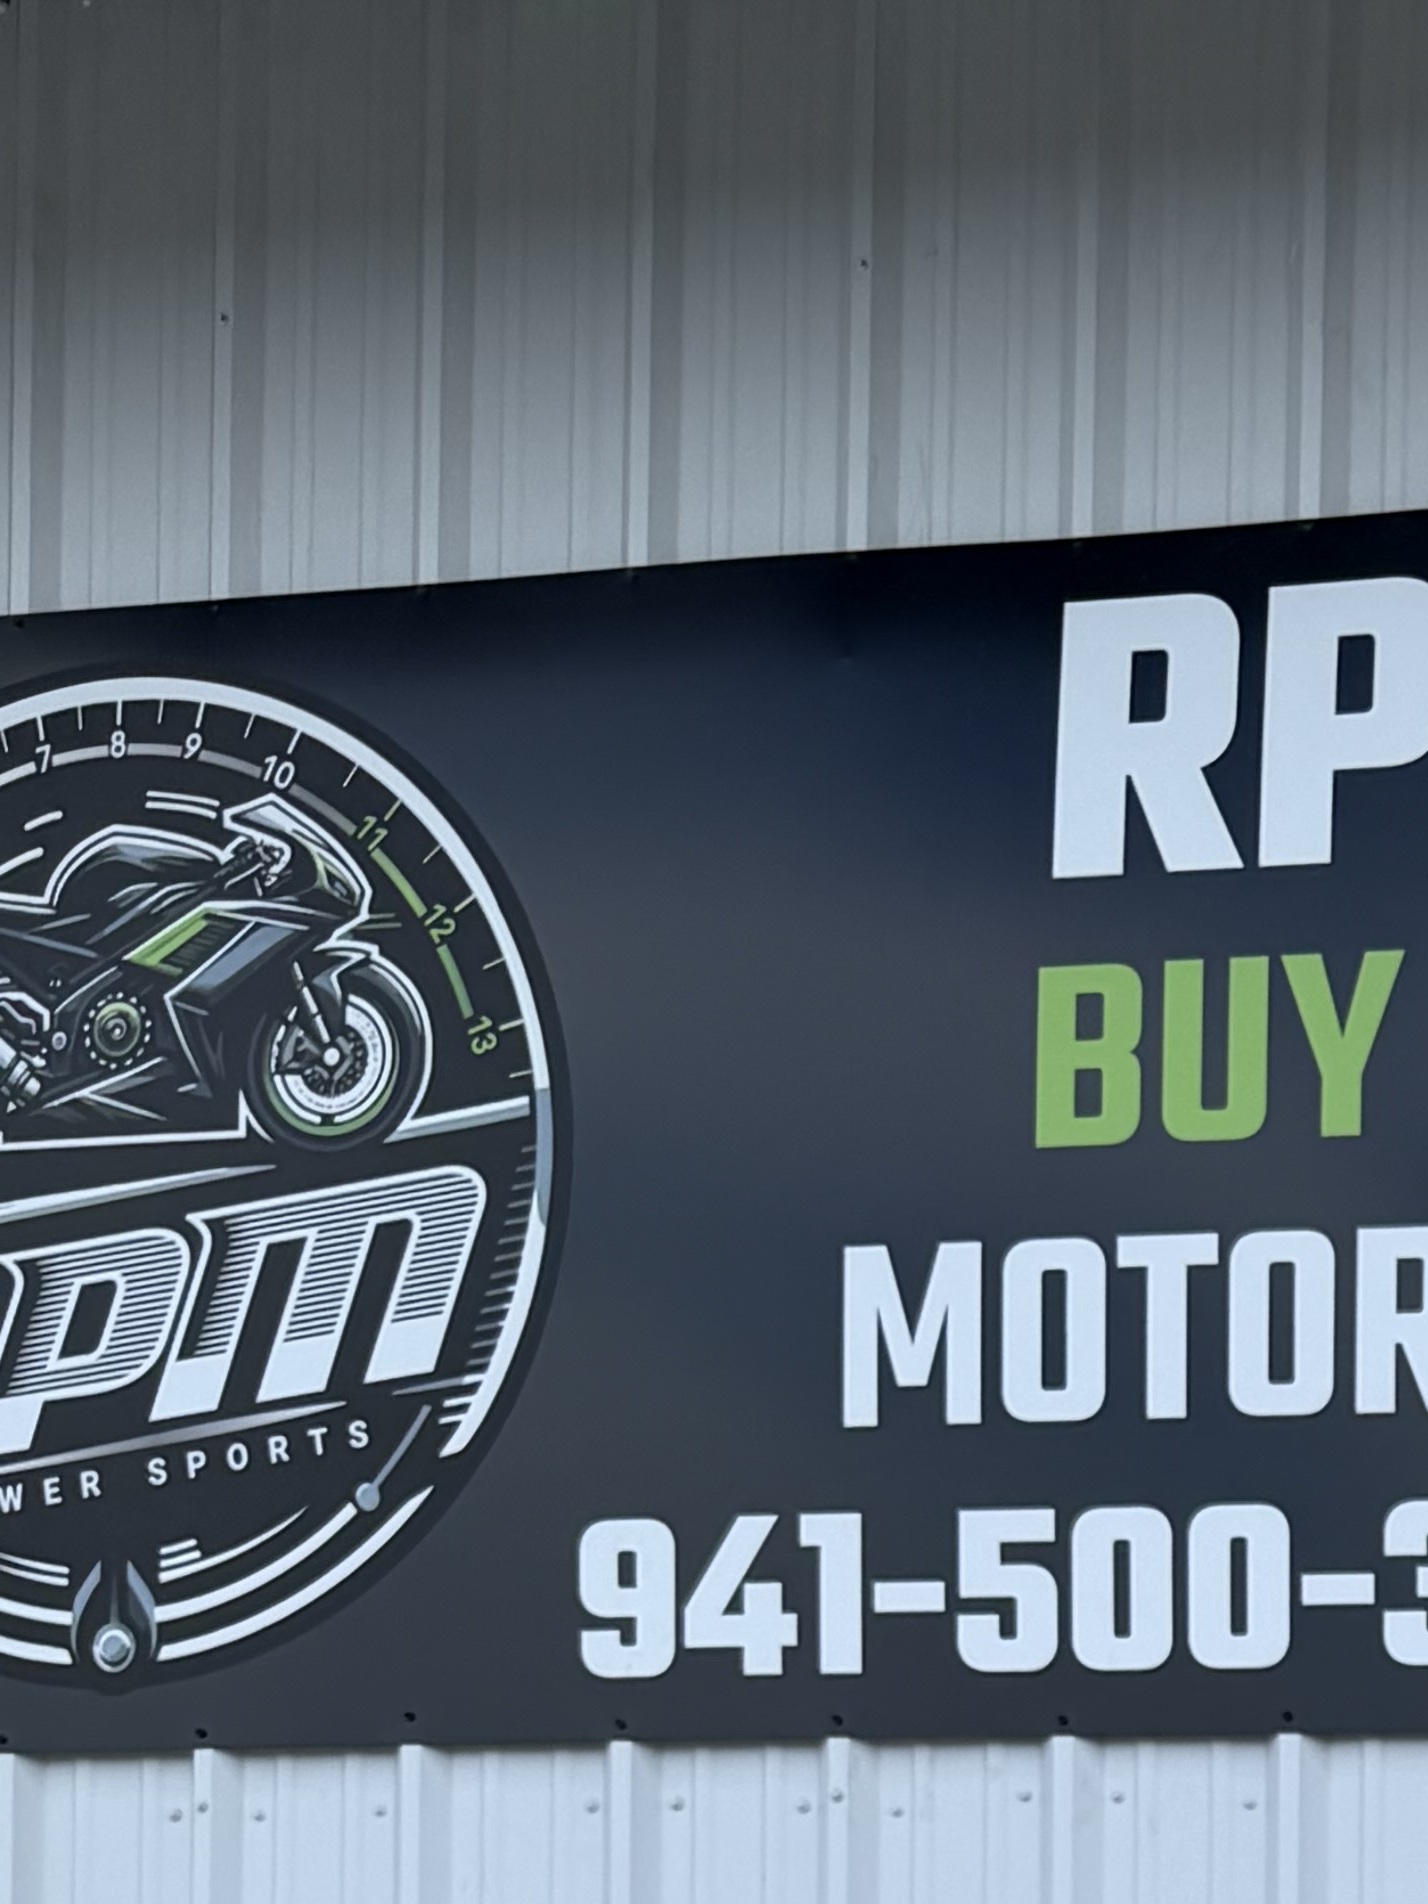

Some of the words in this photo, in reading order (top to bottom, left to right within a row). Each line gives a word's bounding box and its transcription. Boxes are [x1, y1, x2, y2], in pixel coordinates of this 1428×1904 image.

[36, 744, 51, 773] 7
[111, 730, 126, 758] 8
[182, 733, 202, 762] 9
[260, 754, 295, 791] 10
[353, 814, 388, 853] 11
[424, 904, 457, 942] 12
[467, 1015, 496, 1057] 13
[1034, 951, 1402, 1148] BUY
[146, 1419, 370, 1487] SPORTS
